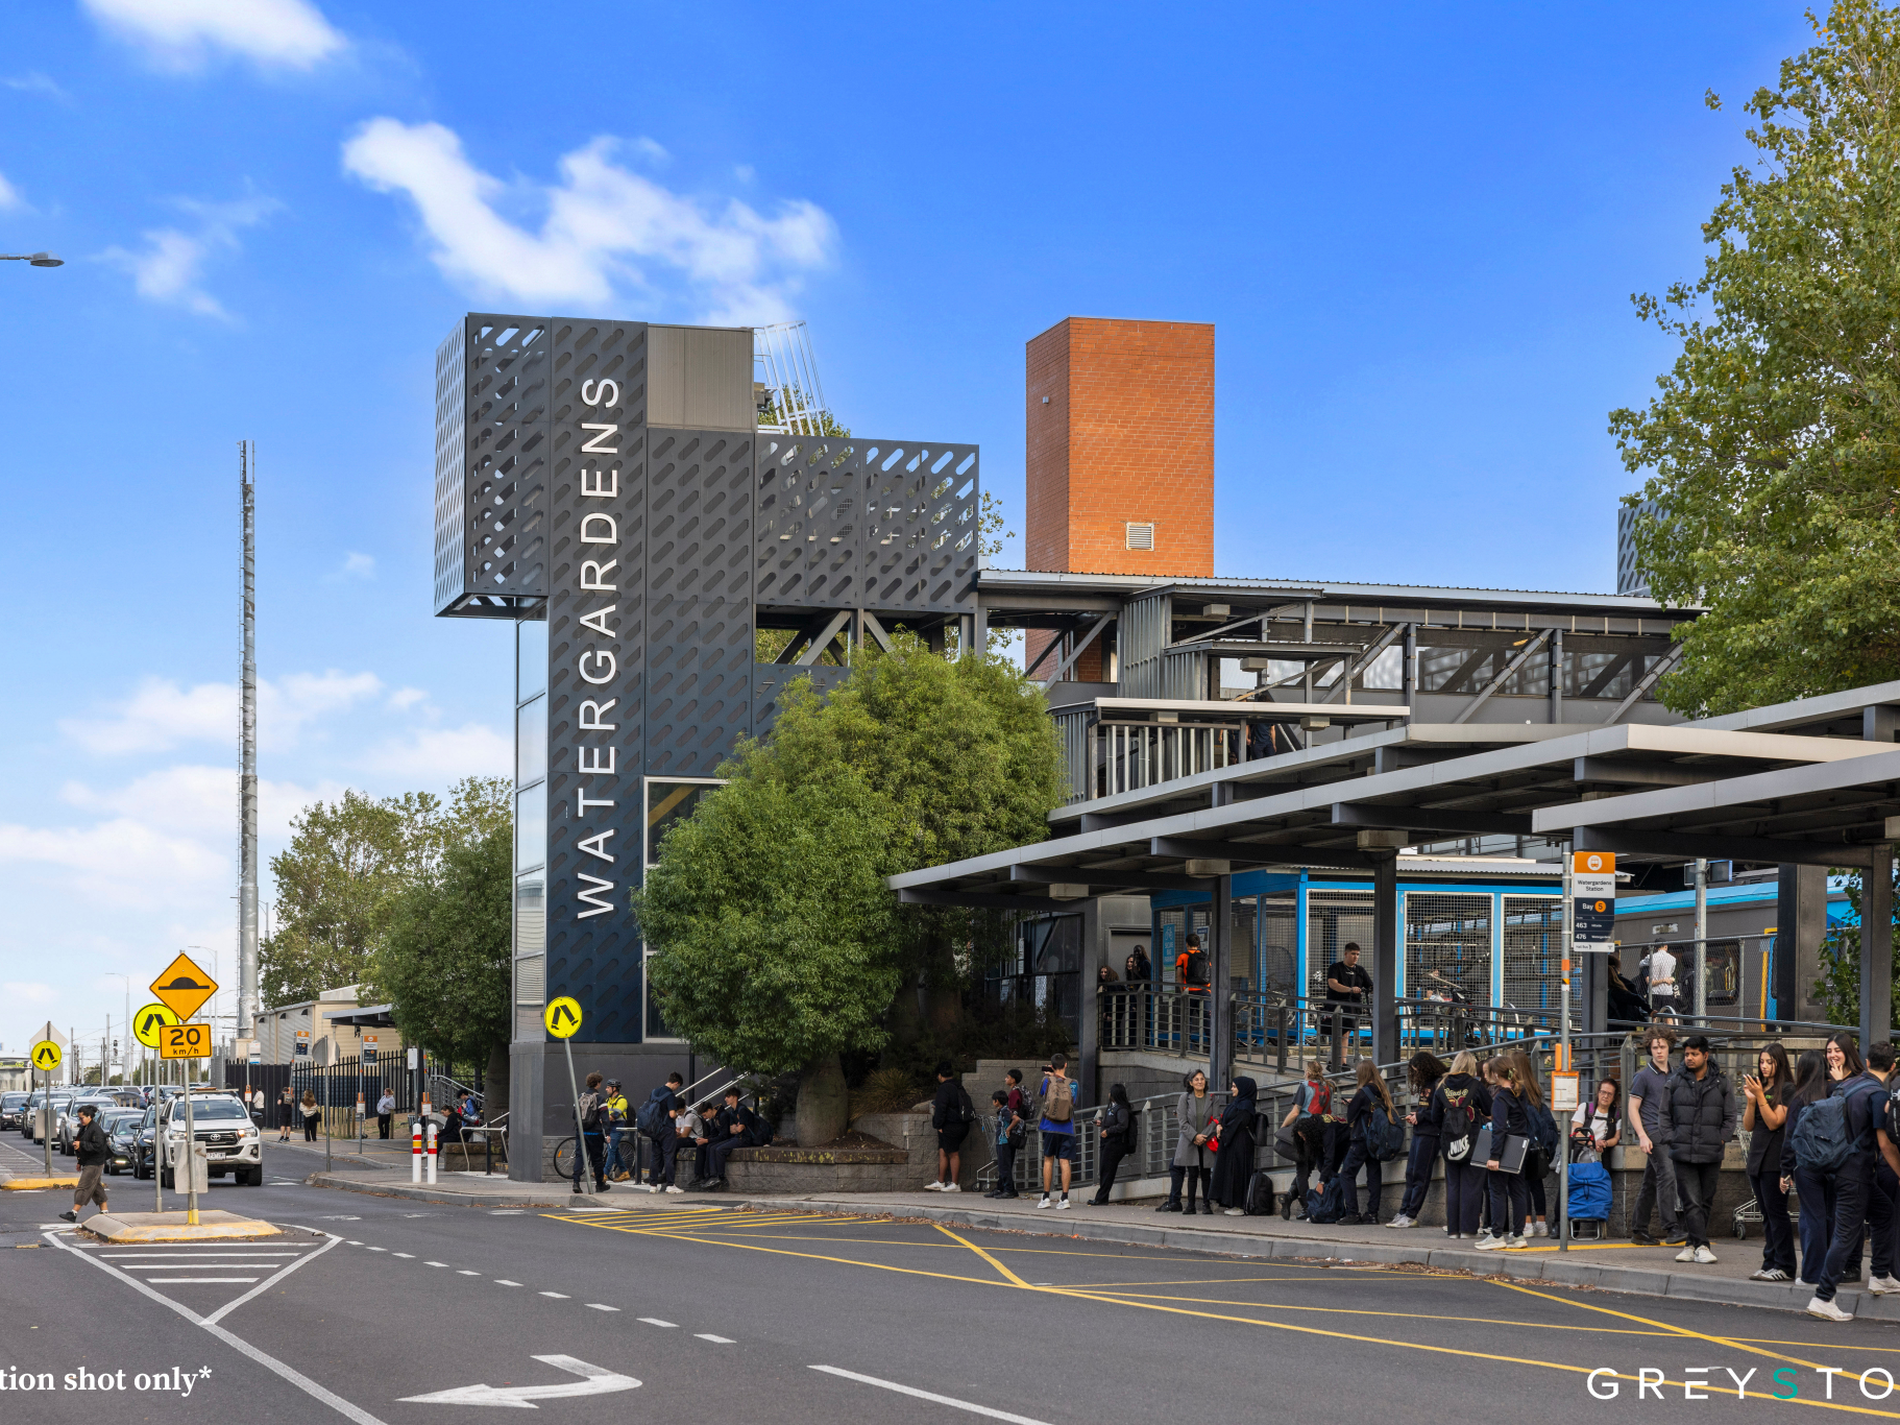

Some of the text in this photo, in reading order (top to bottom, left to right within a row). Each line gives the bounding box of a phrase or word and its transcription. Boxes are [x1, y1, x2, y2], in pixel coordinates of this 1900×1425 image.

[577, 377, 619, 919] WATERGARDENS
[1582, 903, 1594, 911] Bay
[170, 1028, 201, 1046] 20
[173, 1046, 199, 1056] km/h
[1450, 1134, 1469, 1155] NIKE
